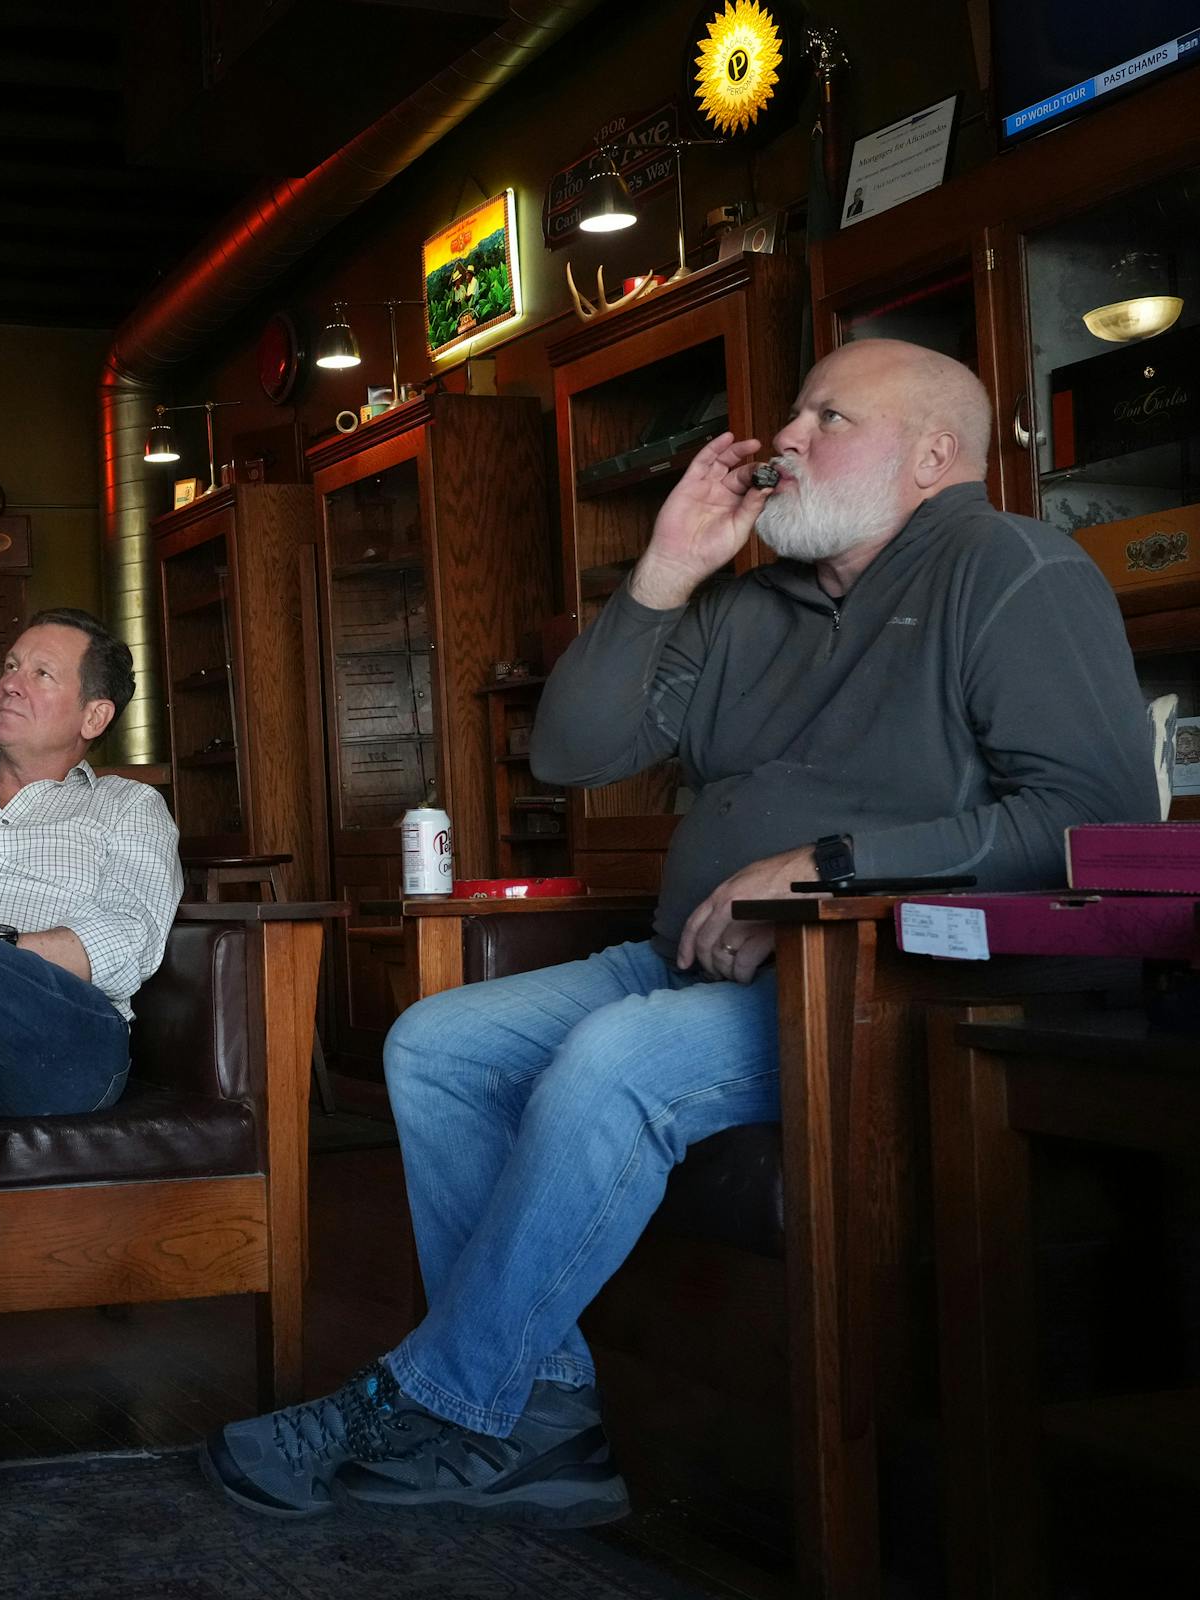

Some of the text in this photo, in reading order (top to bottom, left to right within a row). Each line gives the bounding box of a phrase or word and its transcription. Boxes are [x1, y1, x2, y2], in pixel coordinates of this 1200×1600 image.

[730, 52, 746, 80] P
[1103, 49, 1168, 87] PAST CHAMPS
[1015, 87, 1086, 128] DP WORLD TOUR
[646, 157, 673, 182] Way
